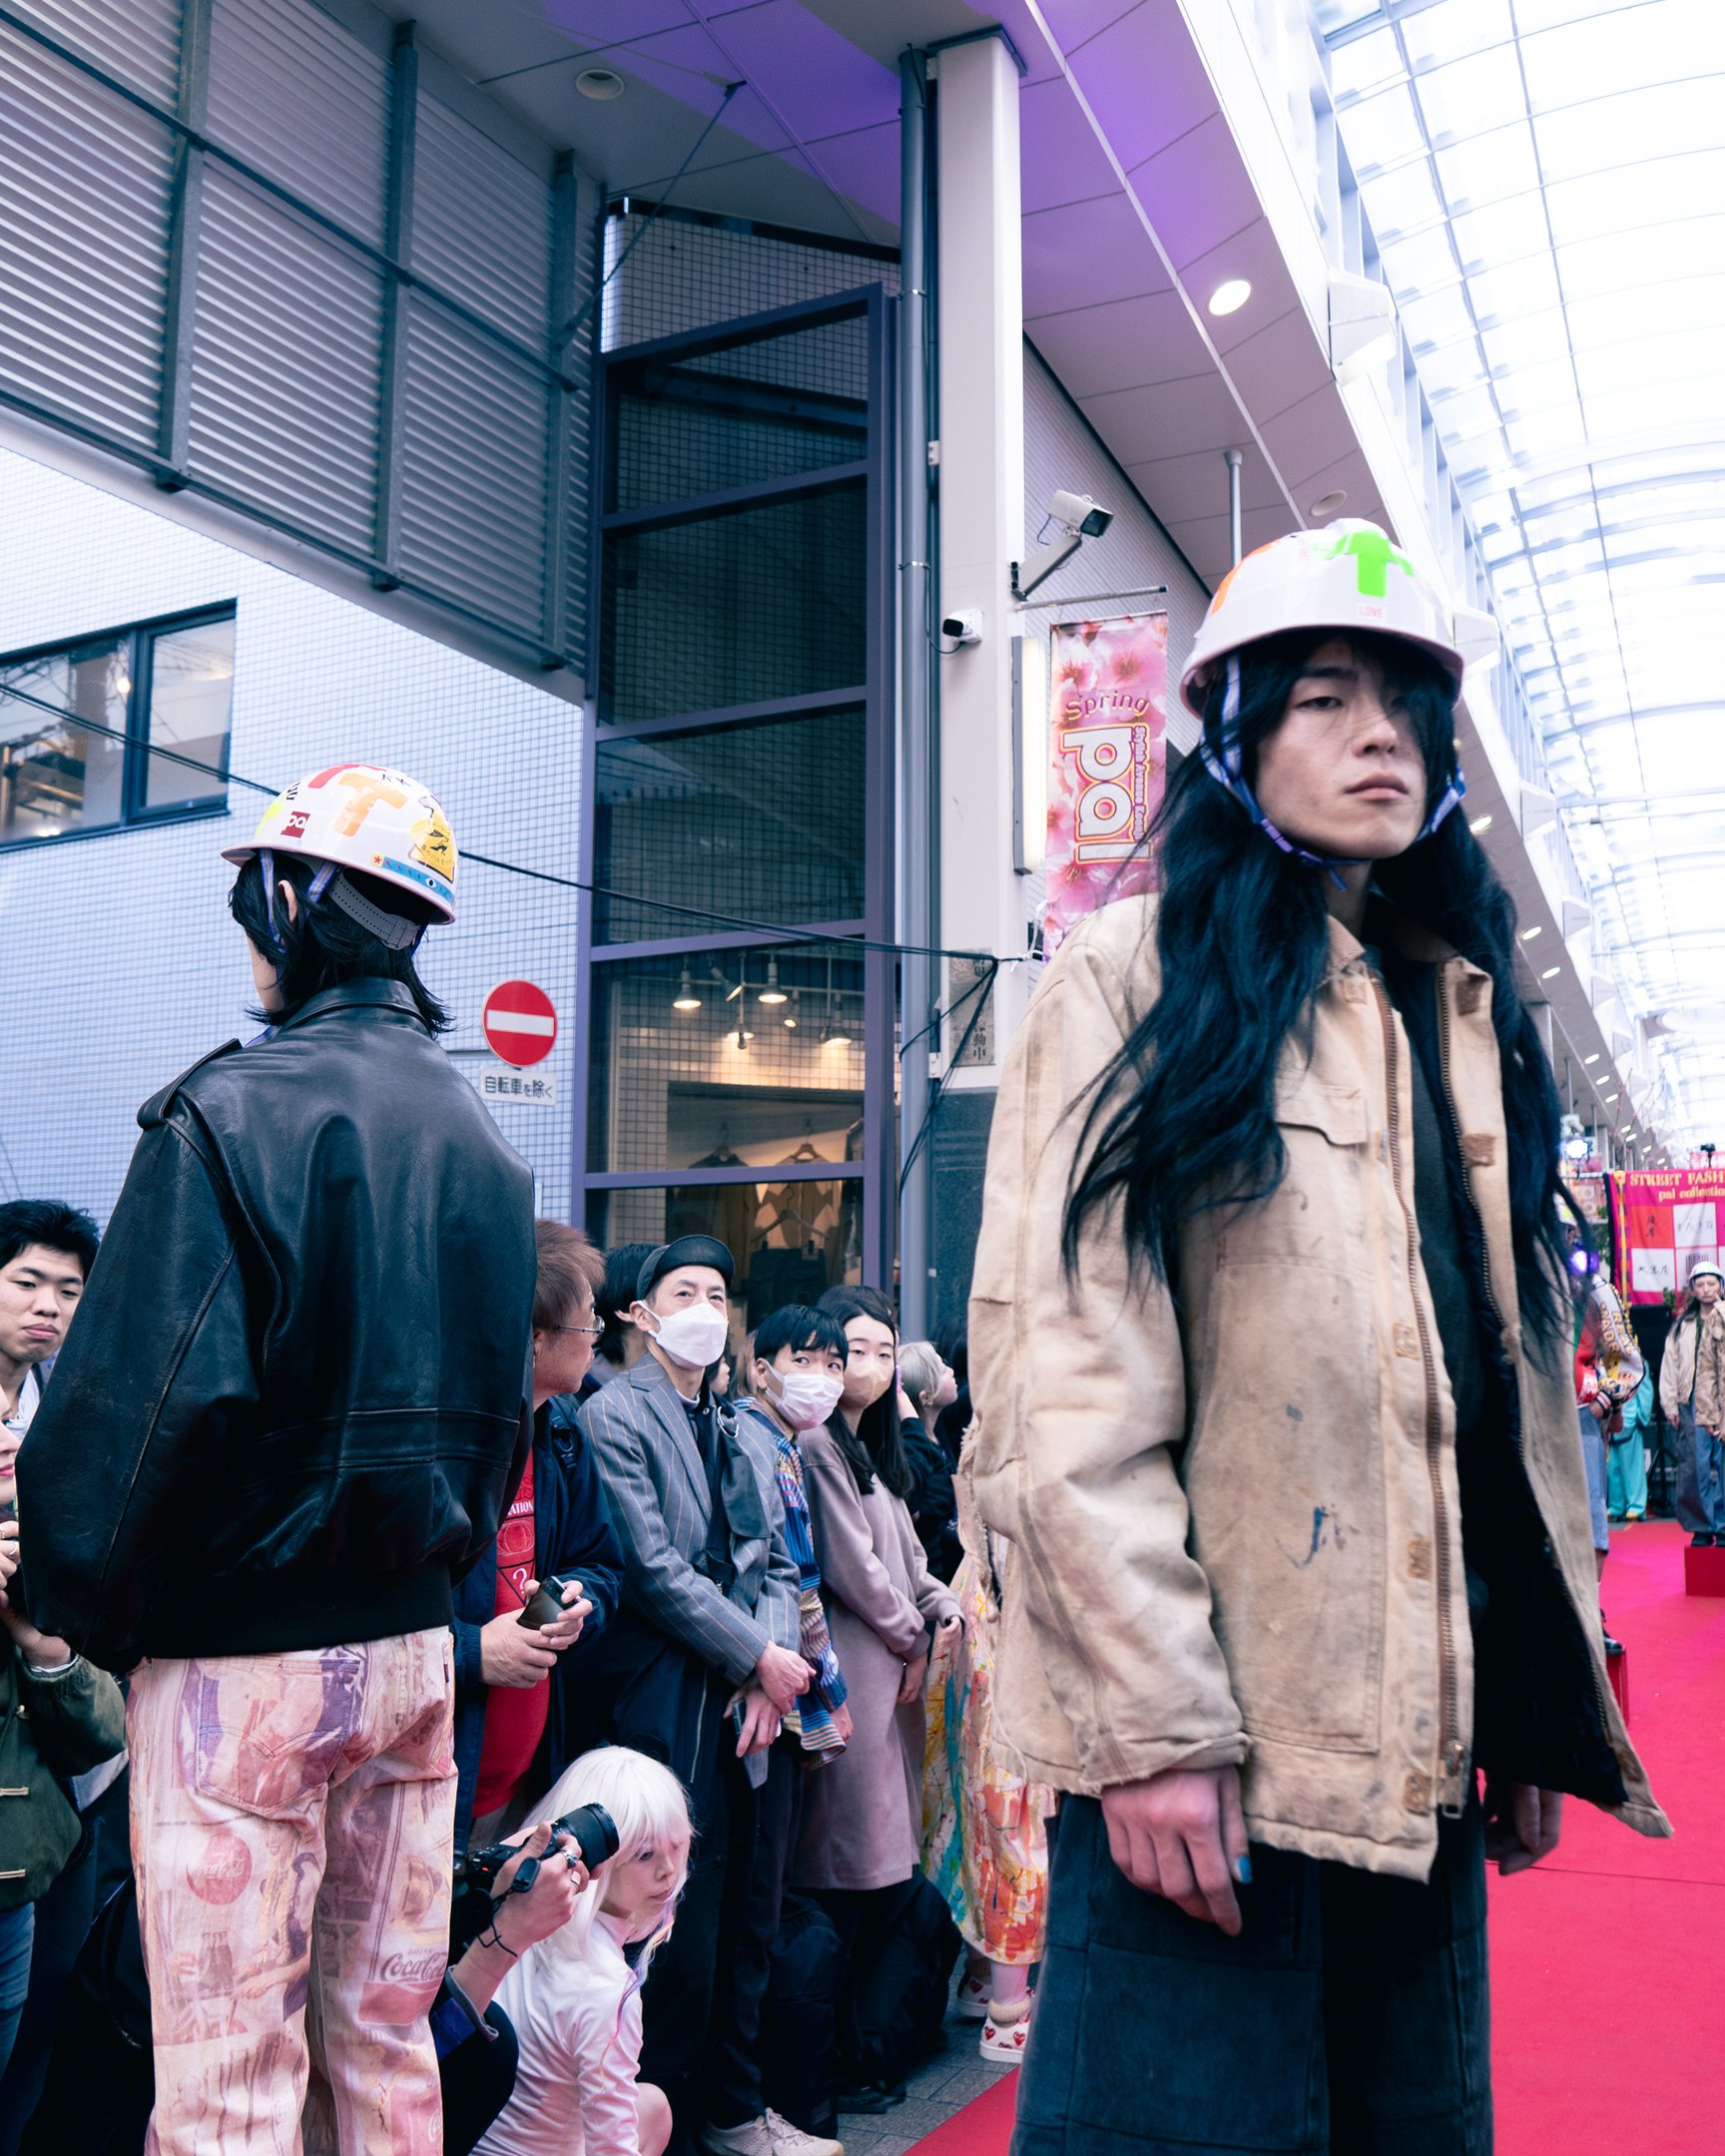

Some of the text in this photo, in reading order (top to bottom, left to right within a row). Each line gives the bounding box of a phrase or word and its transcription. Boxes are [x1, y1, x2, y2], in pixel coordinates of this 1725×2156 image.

[1065, 690, 1149, 720] Spring
[1062, 727, 1151, 861] pal
[1135, 765, 1146, 805] Avenue
[485, 1075, 553, 1099] 自転車を除く
[1630, 1173, 1682, 1186] STREET
[1658, 1187, 1675, 1202] pal
